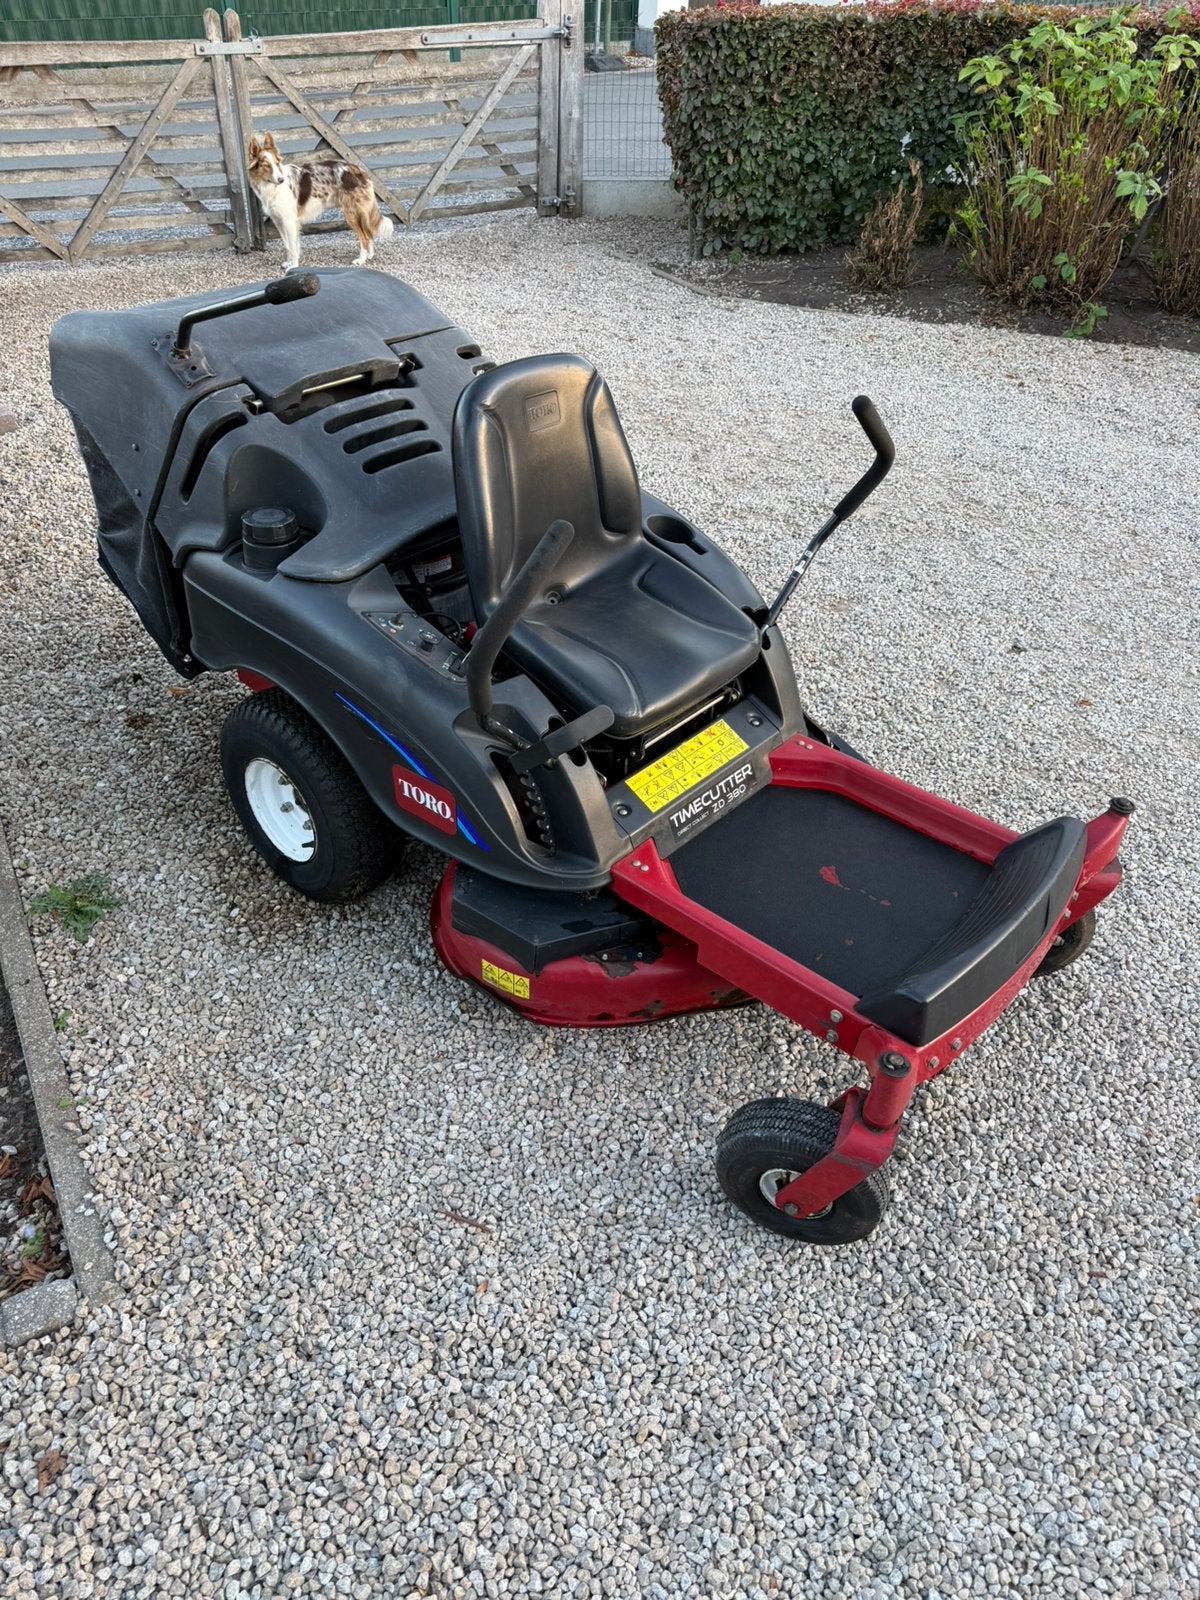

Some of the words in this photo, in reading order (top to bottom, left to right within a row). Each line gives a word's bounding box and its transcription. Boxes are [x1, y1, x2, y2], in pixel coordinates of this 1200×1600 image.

[528, 402, 557, 419] TORO
[398, 778, 452, 820] TORO
[670, 763, 753, 827] TIMECUTTER
[711, 799, 725, 813] ZD
[727, 784, 746, 803] 380
